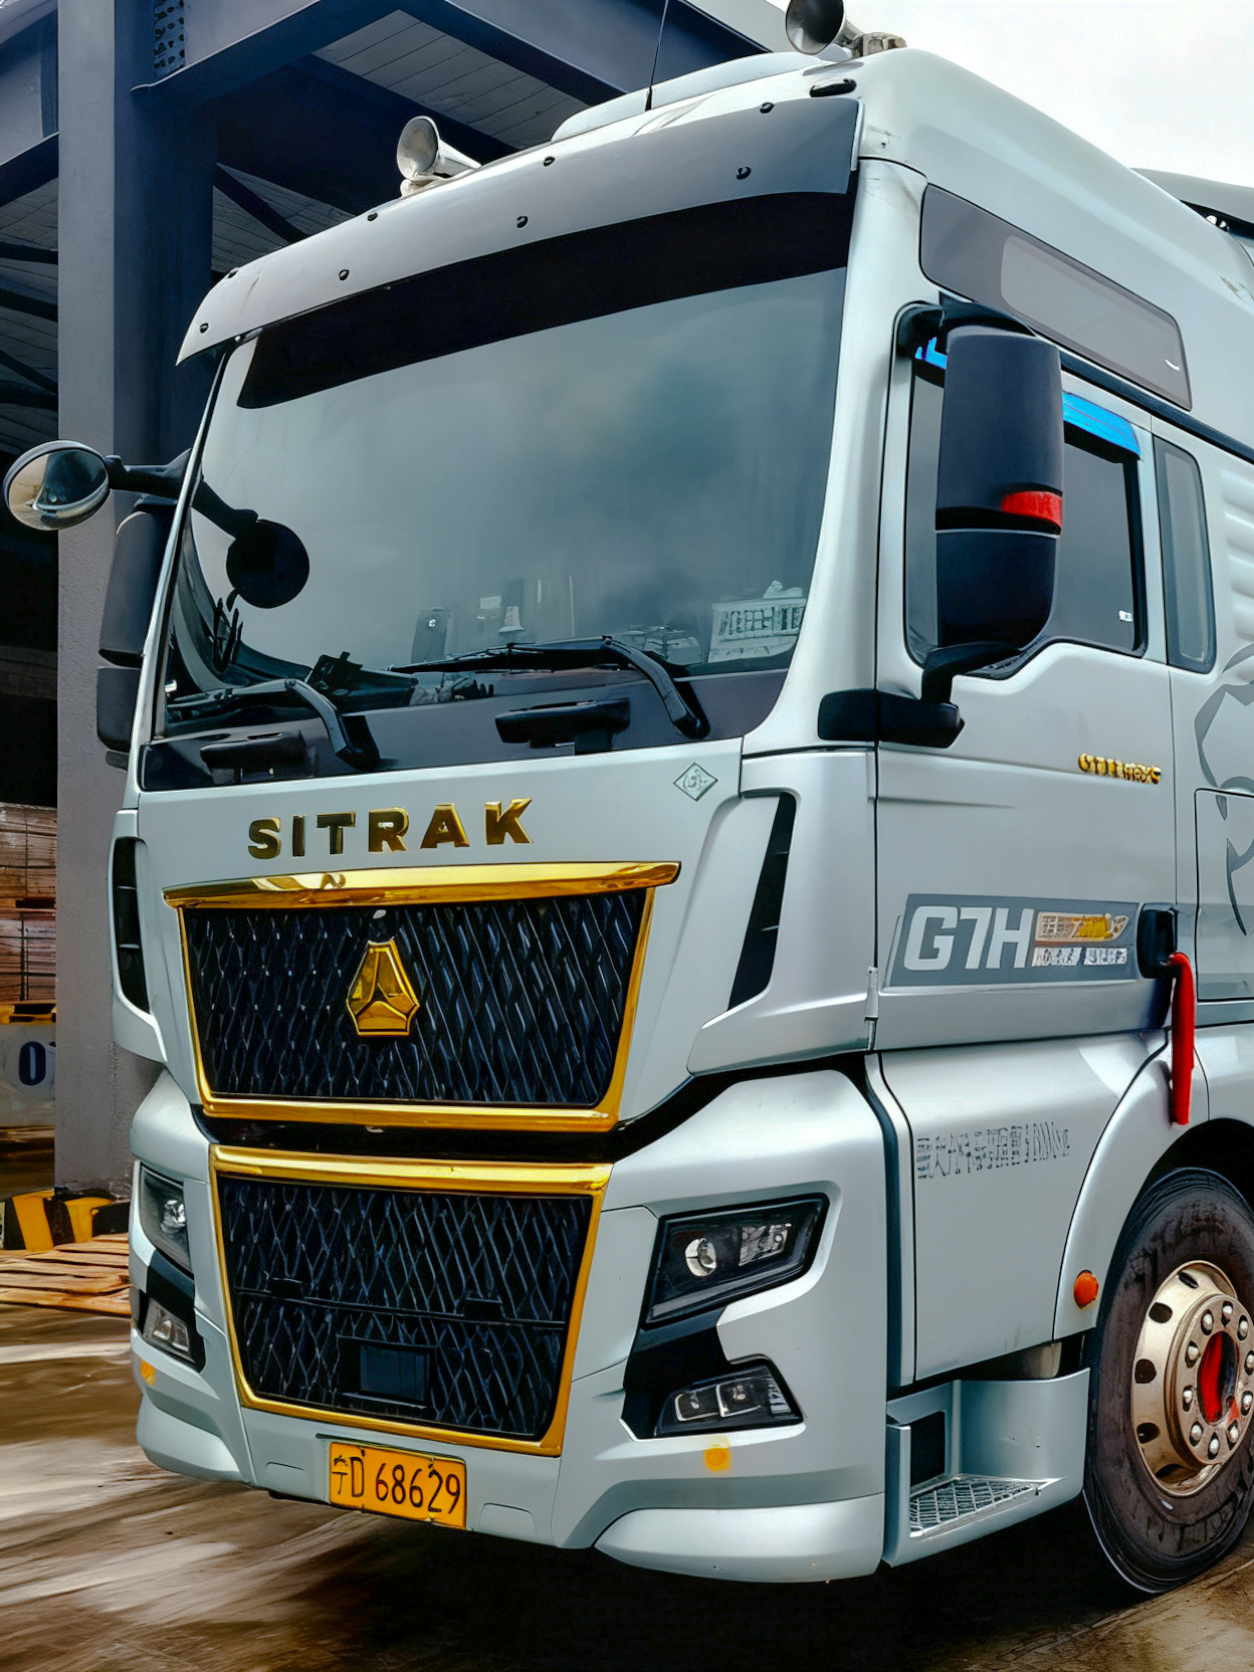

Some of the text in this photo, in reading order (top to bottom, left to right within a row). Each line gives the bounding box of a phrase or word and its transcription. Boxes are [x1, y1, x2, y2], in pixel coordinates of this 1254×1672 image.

[247, 797, 535, 860] SITRAK
[903, 905, 1035, 971] G7H
[375, 1462, 461, 1515] 68629
